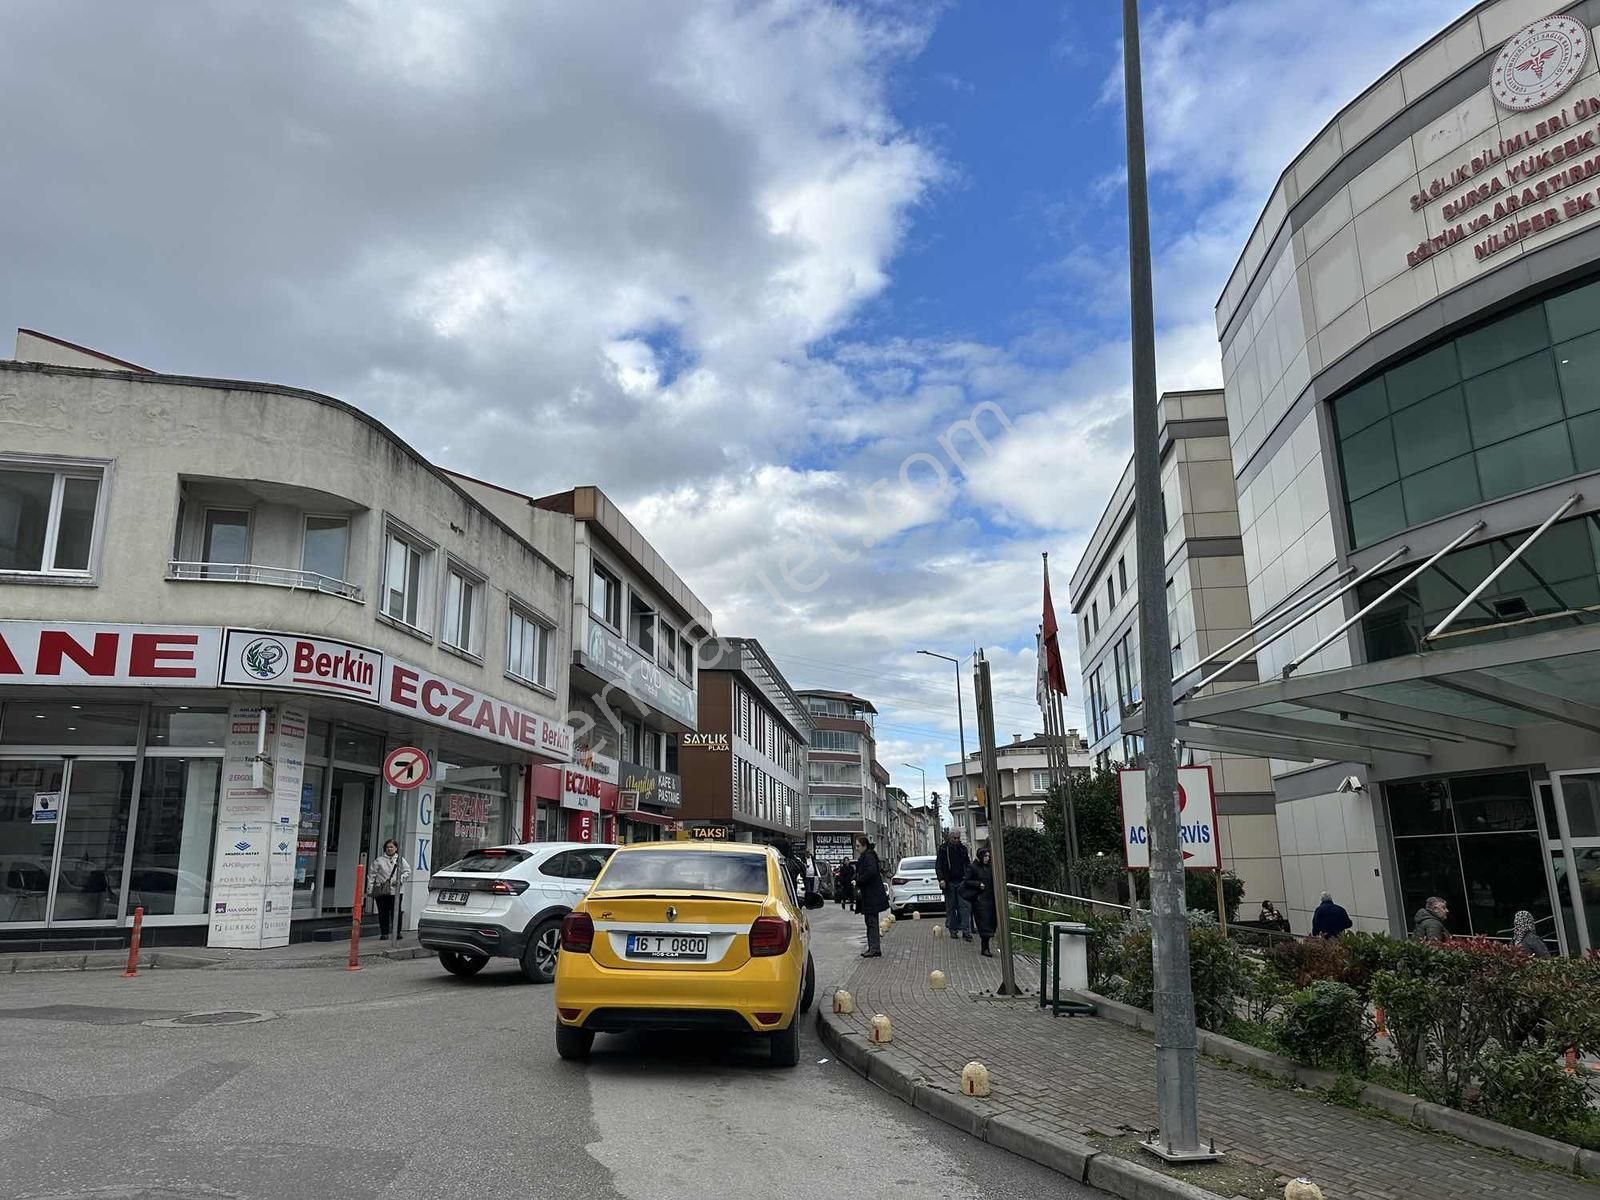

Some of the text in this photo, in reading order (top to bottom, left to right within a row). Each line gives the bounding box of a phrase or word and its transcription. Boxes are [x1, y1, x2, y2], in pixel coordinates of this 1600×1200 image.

[1410, 164, 1471, 211] SAĞLIK
[1470, 109, 1571, 174] BİLİMLERİ
[1441, 130, 1595, 221] BURSA YÜKSEK
[1406, 224, 1464, 267] EĞİTİM
[1467, 213, 1492, 231] ve
[1473, 207, 1561, 260] NİLÜFER
[293, 641, 374, 686] Berkin
[390, 664, 571, 751] ECZANE Berkin
[684, 733, 728, 744] SAYLIK
[565, 770, 601, 798] ECZANE
[657, 775, 671, 789] KAFE
[658, 789, 680, 804] PASTANE
[1129, 820, 1210, 844] AC RVİS
[635, 938, 705, 952] 16 T 0800
